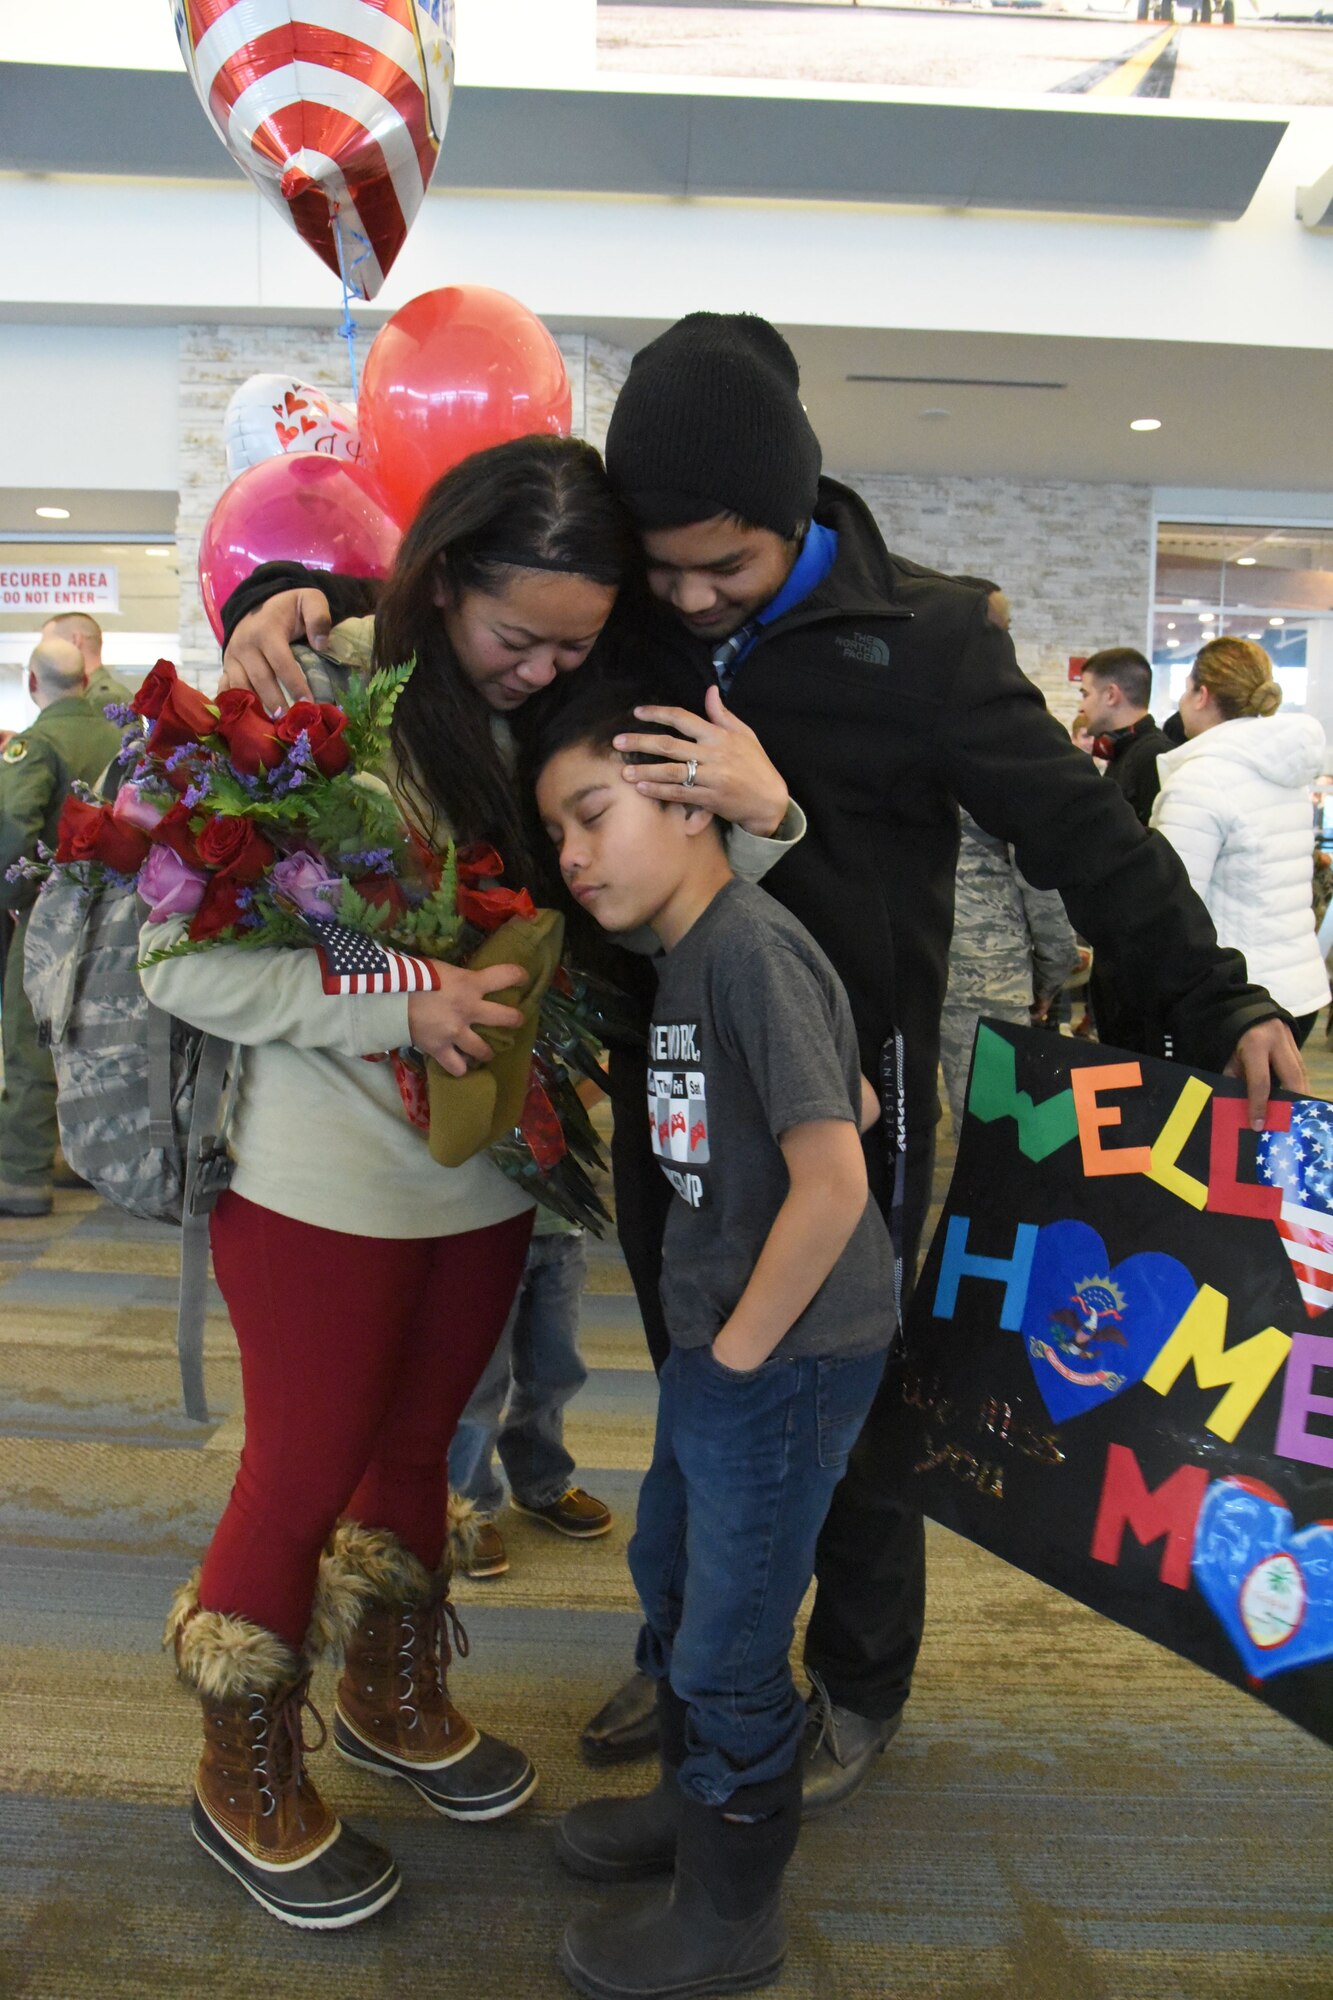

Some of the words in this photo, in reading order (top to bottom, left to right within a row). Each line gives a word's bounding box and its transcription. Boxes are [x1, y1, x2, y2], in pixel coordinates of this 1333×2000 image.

[0, 572, 62, 587] ECURED
[68, 572, 107, 587] AREA
[4, 591, 20, 603] DO
[25, 591, 49, 603] NOT
[54, 591, 95, 603] ENTER
[835, 636, 872, 653] NORTH
[854, 632, 873, 645] THE
[843, 648, 872, 663] FACE
[883, 1054, 895, 1138] DESTINY
